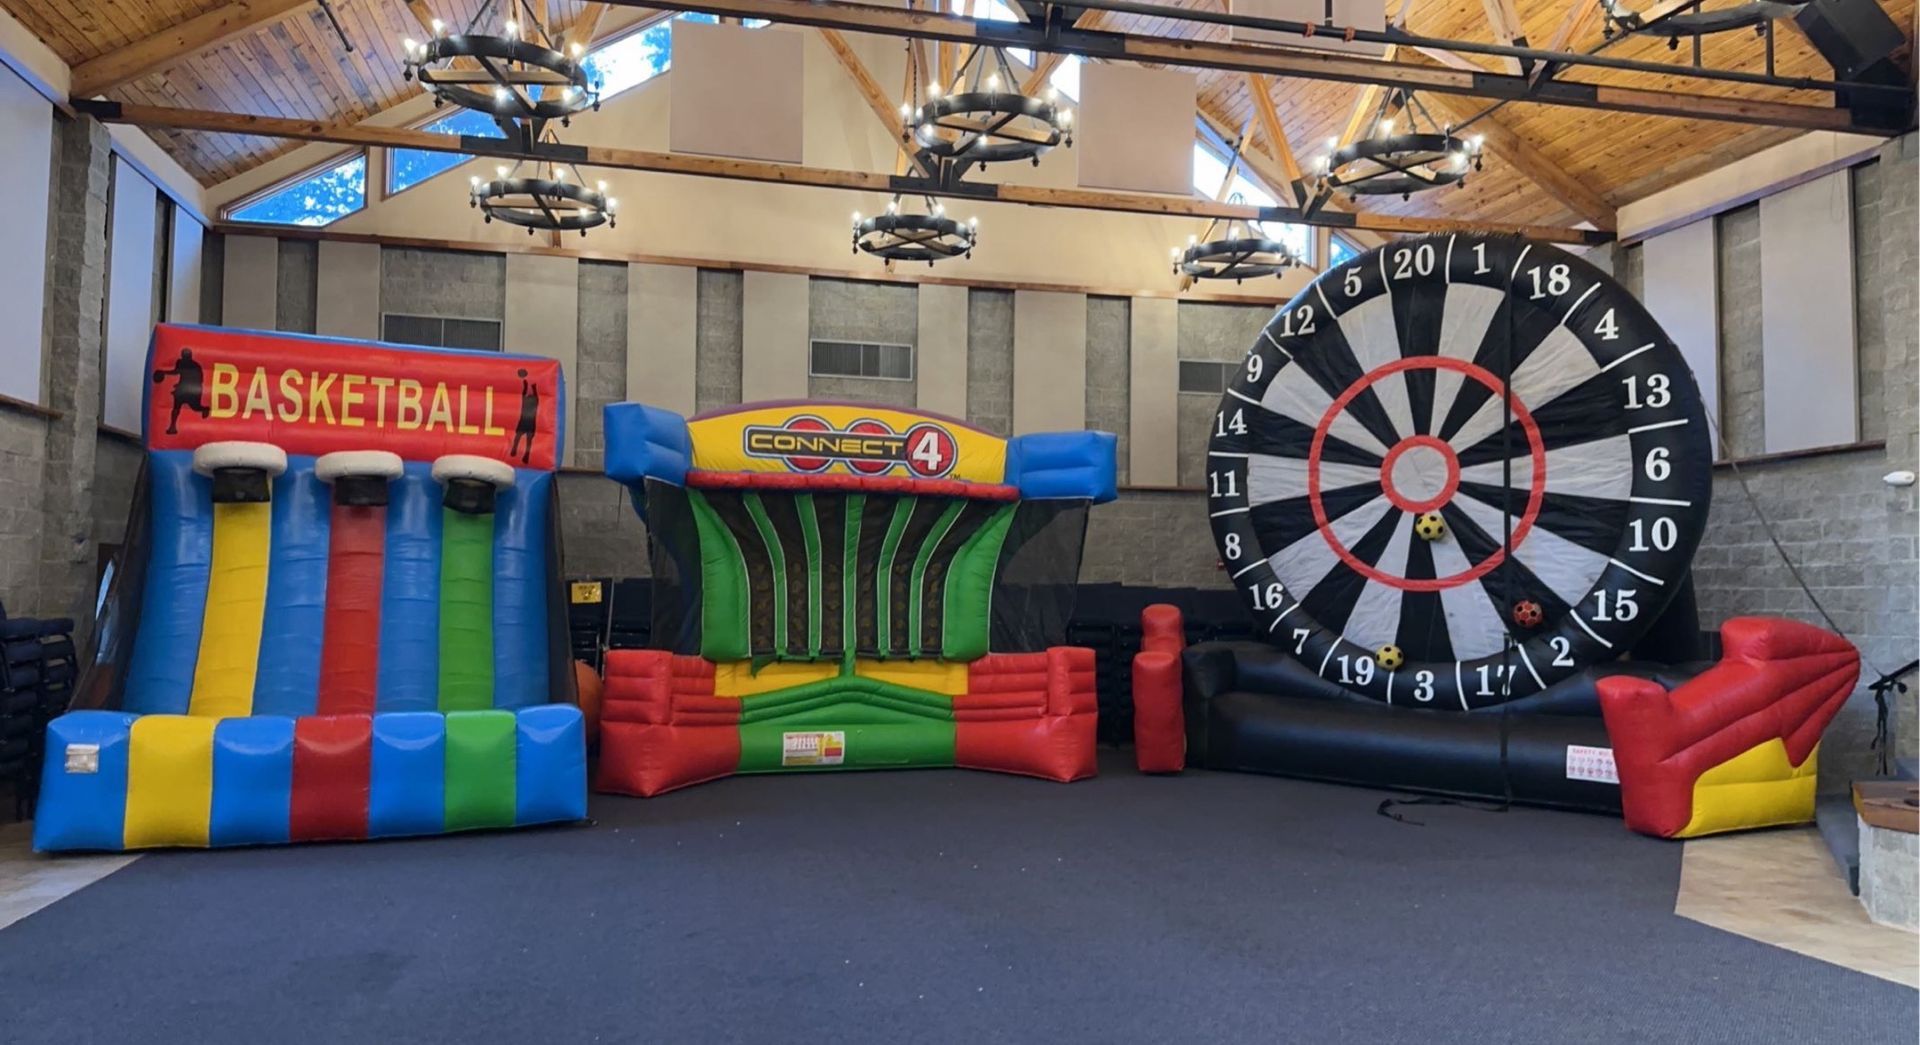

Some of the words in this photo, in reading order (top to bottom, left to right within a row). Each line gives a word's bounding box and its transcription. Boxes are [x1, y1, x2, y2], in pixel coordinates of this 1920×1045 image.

[1394, 244, 1434, 279] 20
[1473, 243, 1490, 274] 1
[1345, 267, 1361, 296] 5
[1527, 264, 1570, 299] 18
[1281, 306, 1315, 337] 12
[1594, 308, 1619, 340] 4
[1247, 354, 1263, 382] 9
[210, 363, 505, 436] BASKETBALL
[1622, 374, 1670, 408] 13
[1215, 410, 1247, 437] 14
[751, 433, 903, 455] CONNECT
[912, 431, 942, 470] 4
[1645, 447, 1670, 481] 6
[1211, 471, 1240, 497] 11
[1226, 533, 1241, 559] 8
[1629, 517, 1677, 551] 10
[1250, 583, 1283, 609] 16
[1592, 589, 1638, 621] 15
[1293, 629, 1310, 654] 7
[1550, 637, 1574, 666] 2
[1337, 655, 1374, 685] 19
[1476, 665, 1516, 695] 17
[1414, 671, 1434, 701] 3
